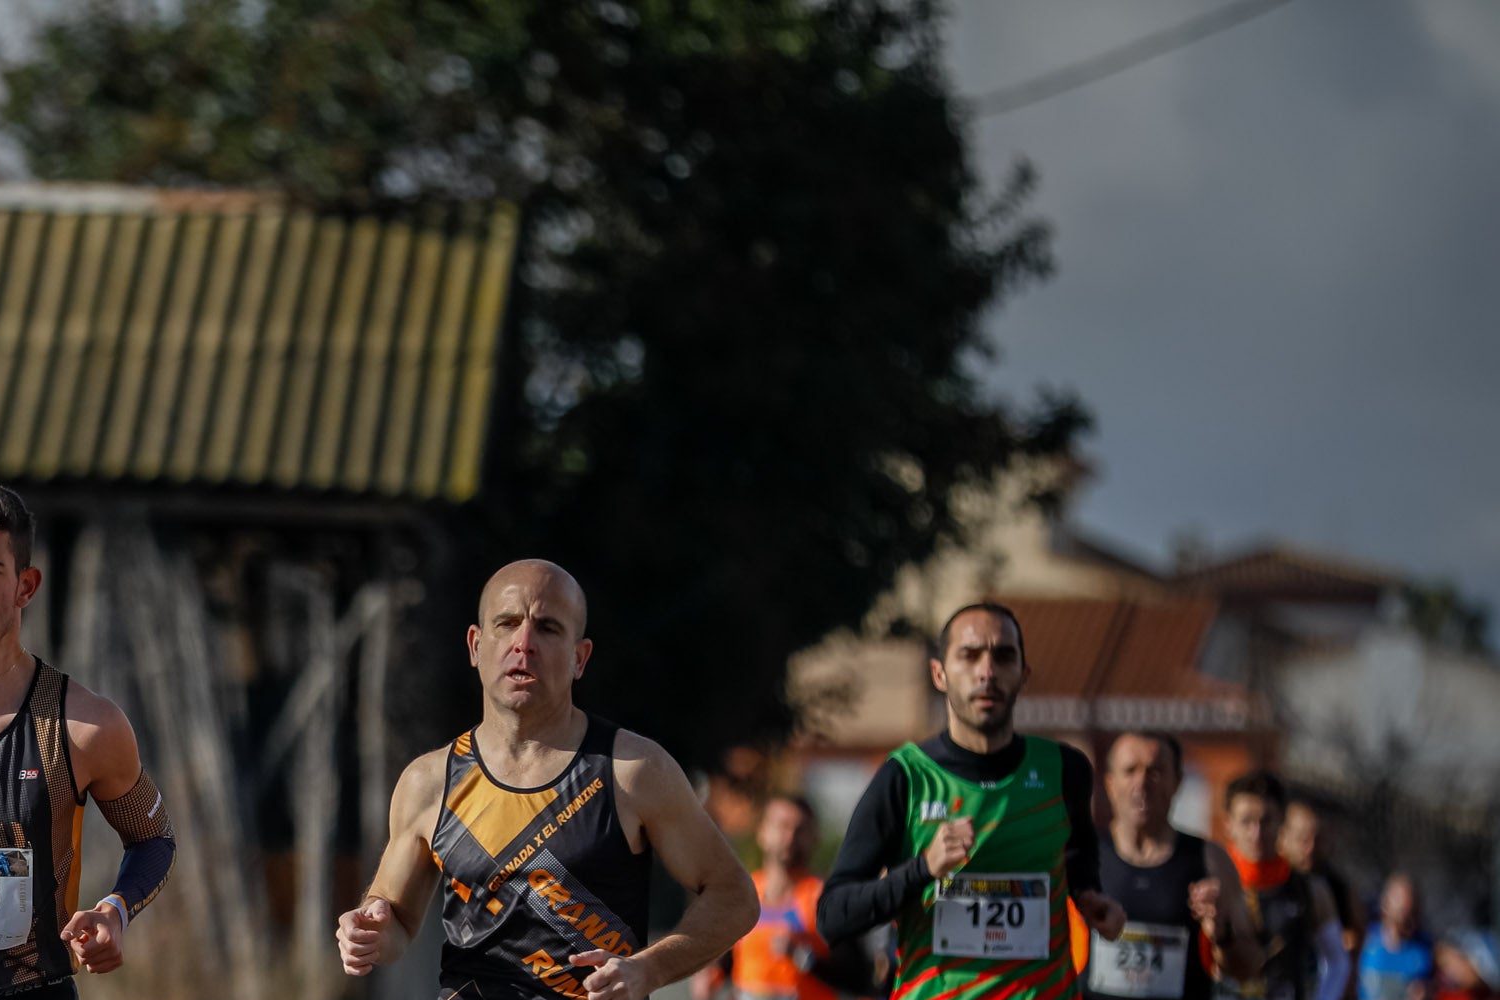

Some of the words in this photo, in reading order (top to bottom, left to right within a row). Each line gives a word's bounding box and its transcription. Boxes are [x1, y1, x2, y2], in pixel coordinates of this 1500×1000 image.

[488, 844, 536, 892] GRANADA
[533, 833, 545, 847] X
[541, 823, 558, 838] EL
[555, 778, 604, 826] RUNNING
[527, 869, 634, 958] GRANAD
[966, 902, 1025, 928] 120
